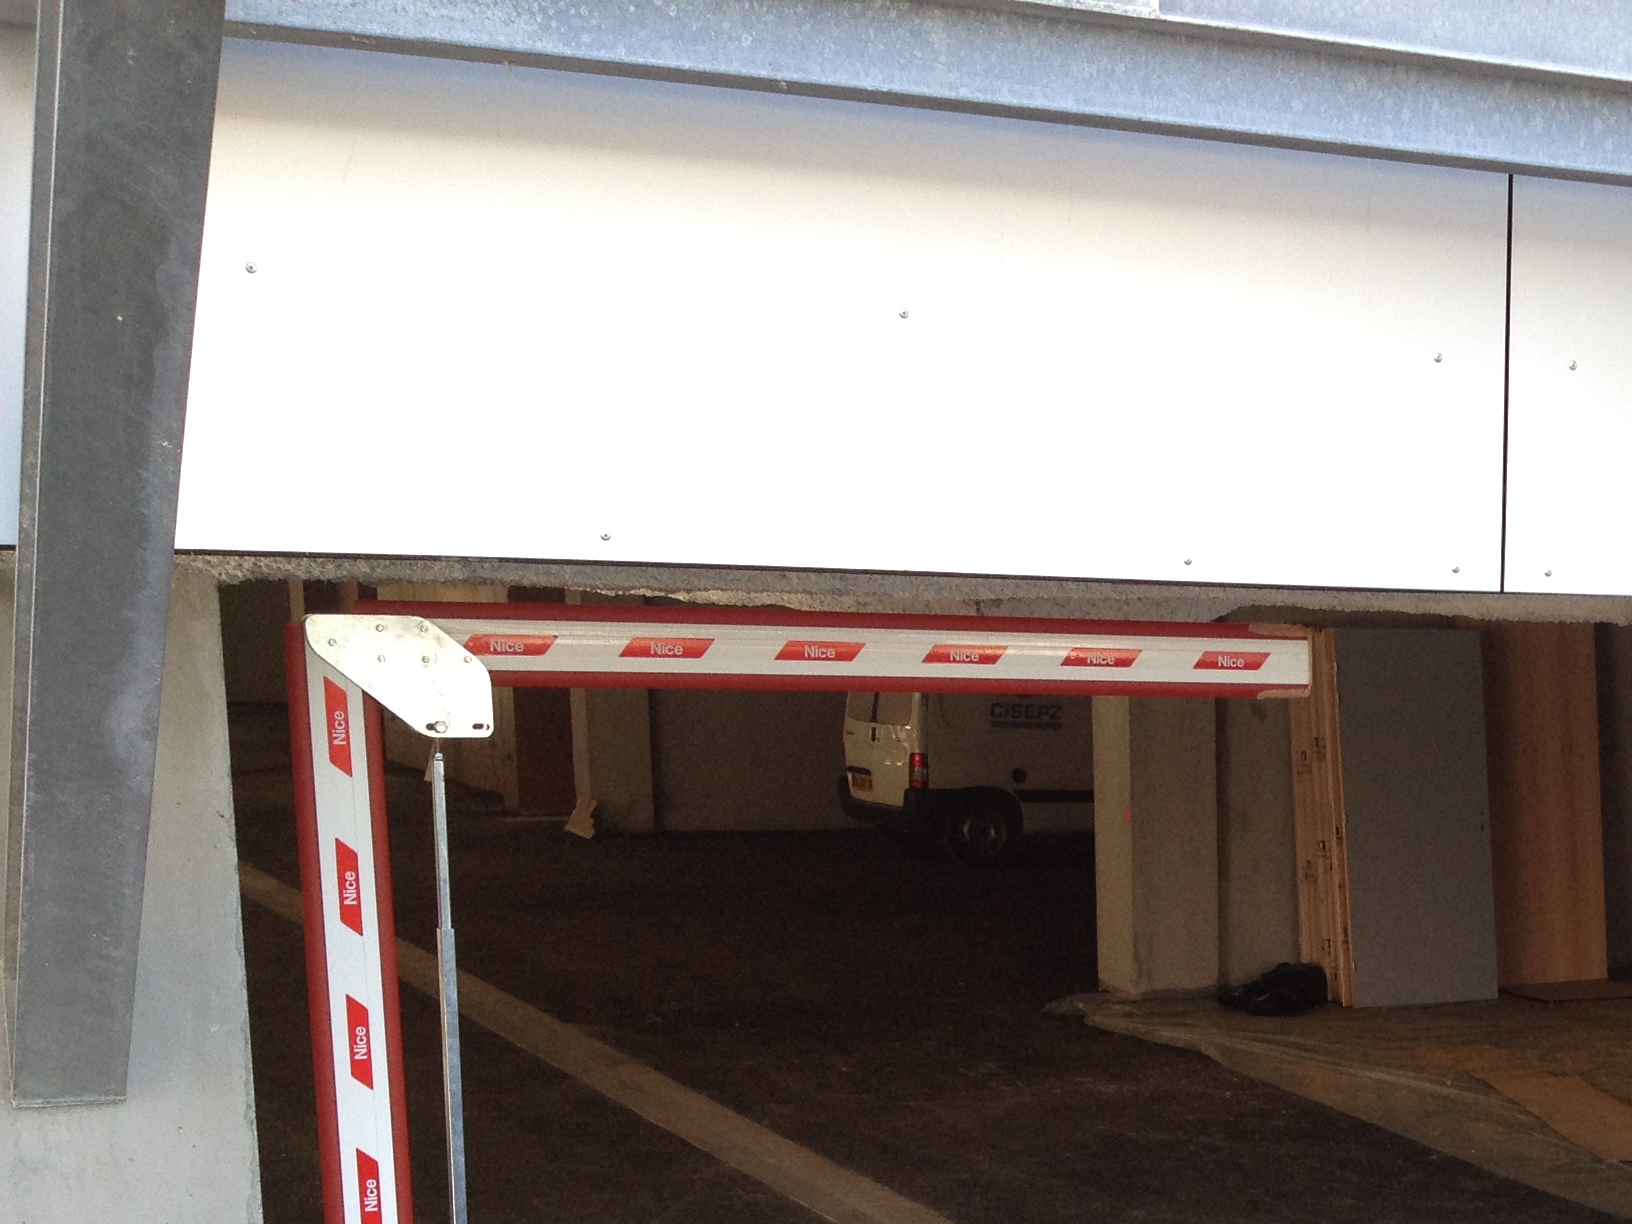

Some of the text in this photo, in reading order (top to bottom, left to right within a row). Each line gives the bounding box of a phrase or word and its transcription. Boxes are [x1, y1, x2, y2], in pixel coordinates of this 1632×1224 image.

[489, 640, 524, 653] Nice
[650, 643, 683, 656] Nice
[804, 645, 836, 658] Nice
[949, 650, 980, 662] Nice
[1087, 654, 1115, 665] Nice
[1217, 656, 1244, 668] Nice
[332, 710, 347, 745] Nice
[343, 871, 358, 905] Nice
[354, 1026, 368, 1060] Nice
[364, 1178, 378, 1213] Nice
